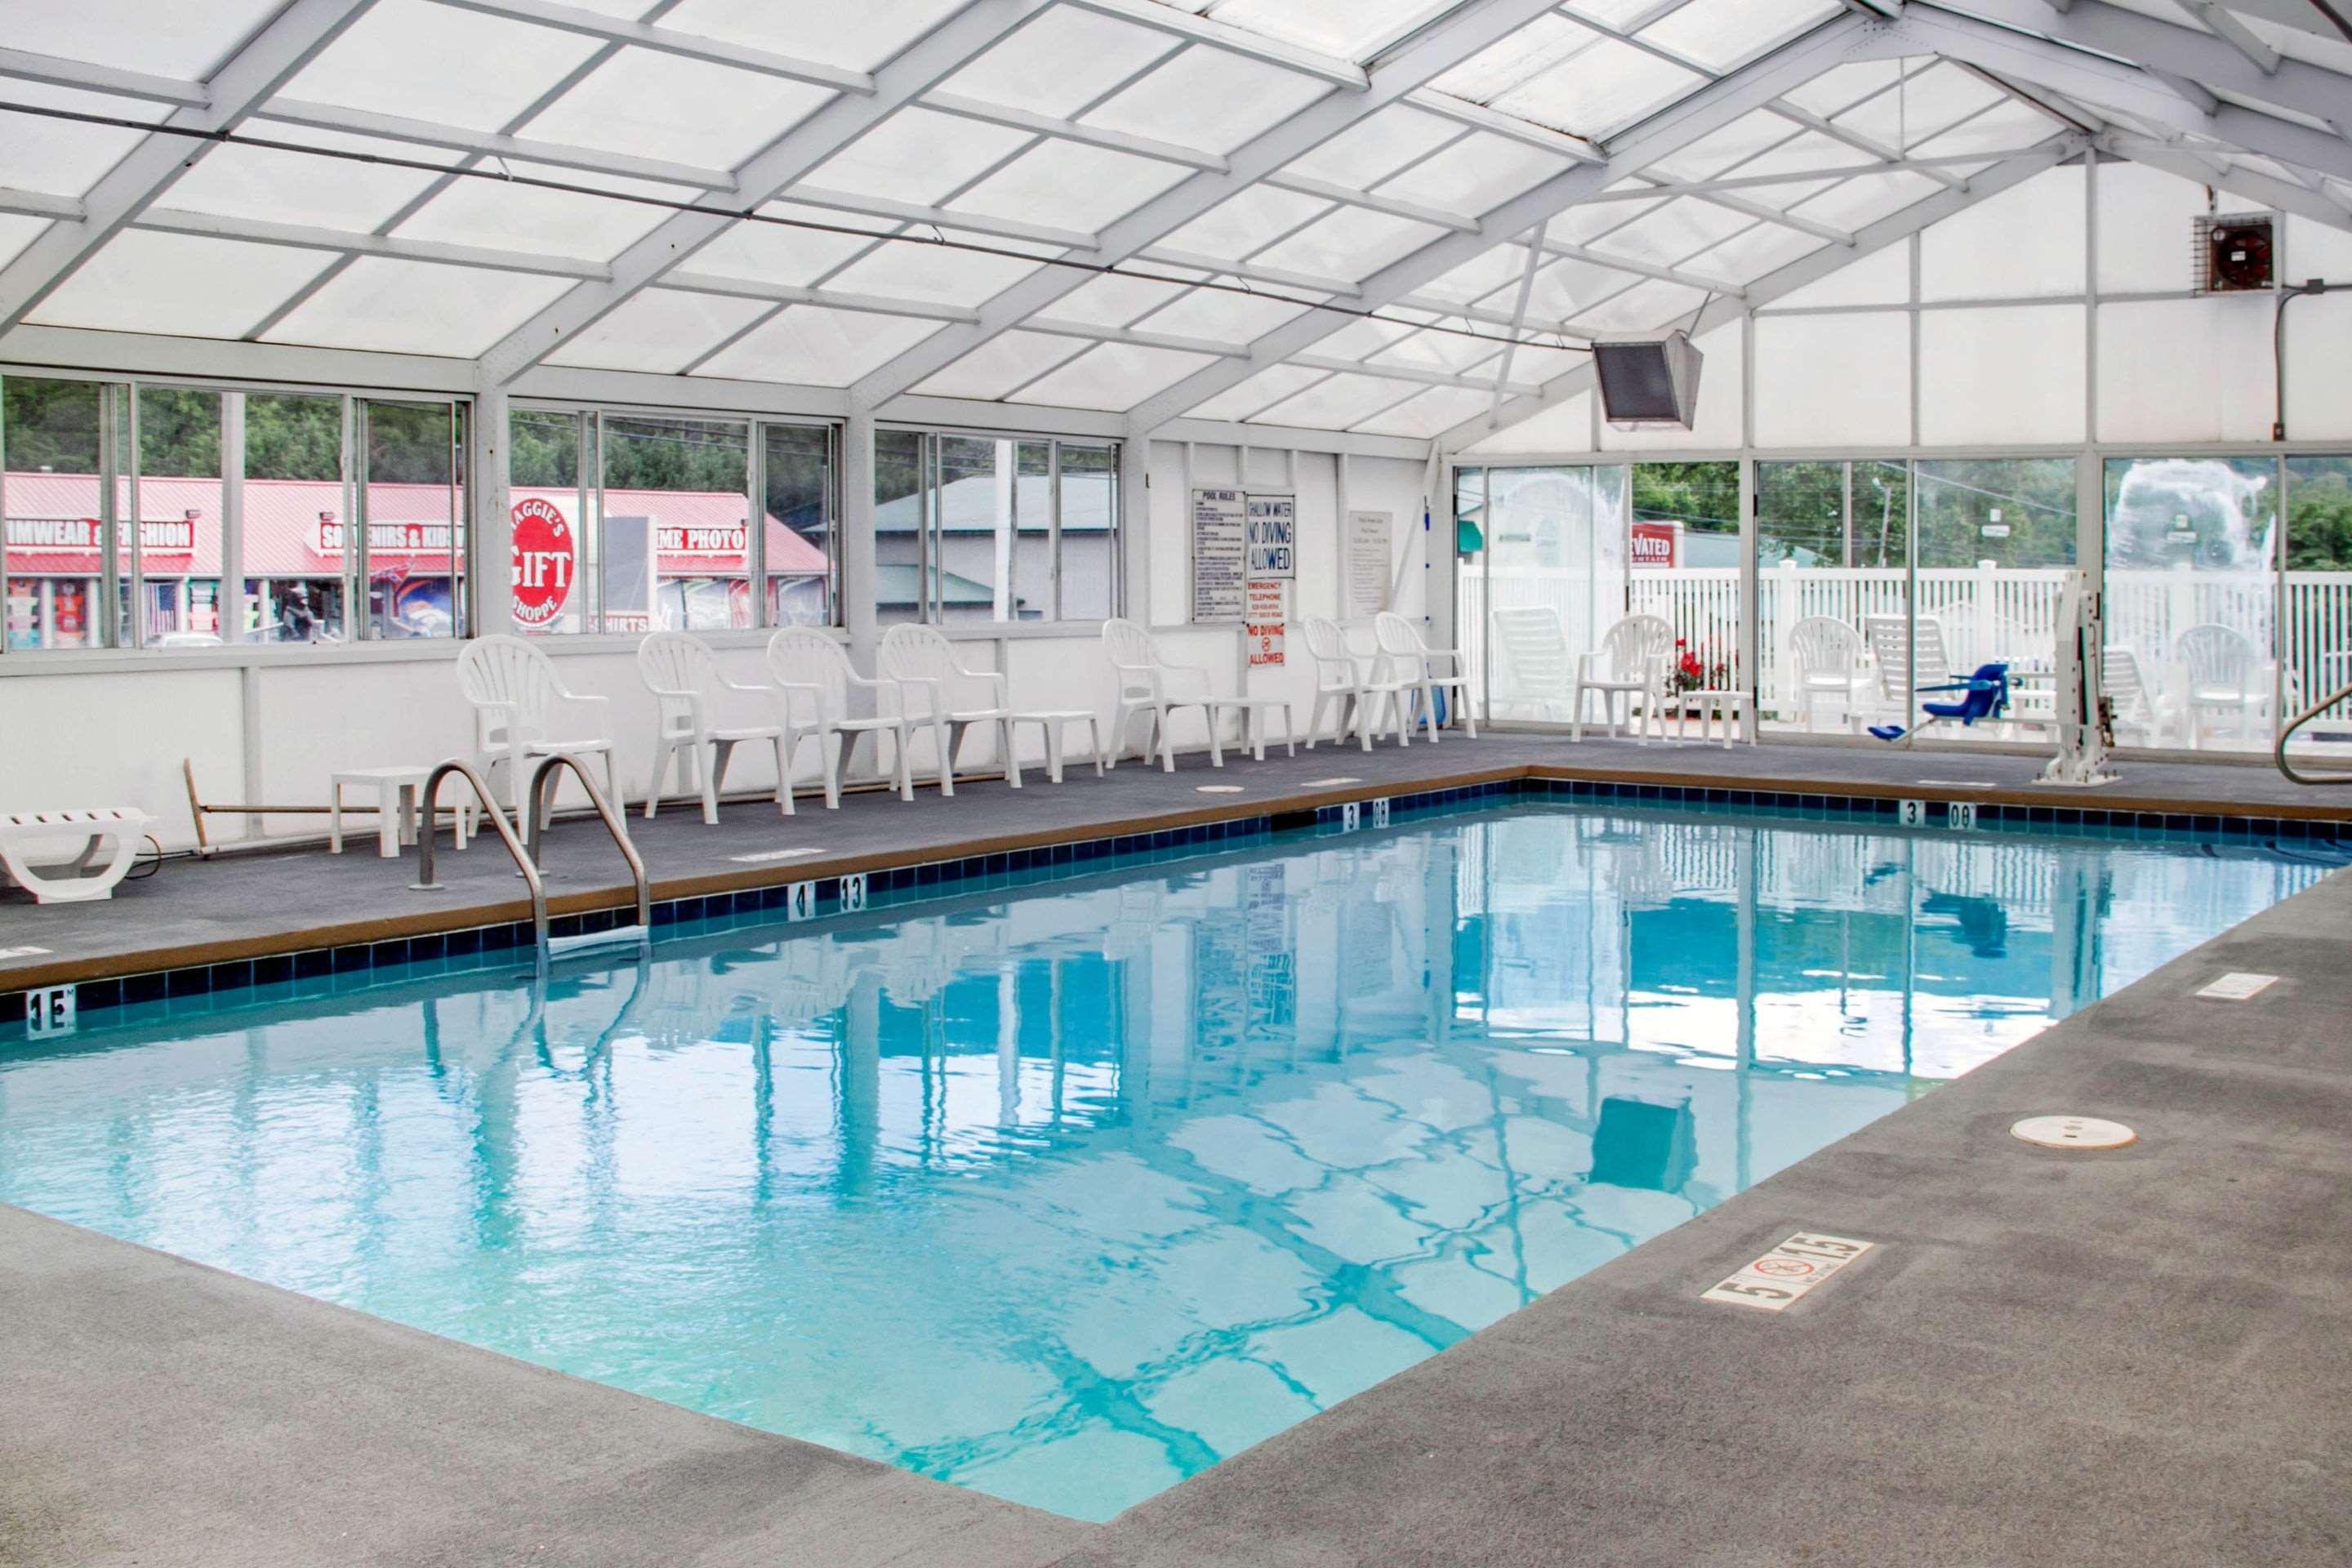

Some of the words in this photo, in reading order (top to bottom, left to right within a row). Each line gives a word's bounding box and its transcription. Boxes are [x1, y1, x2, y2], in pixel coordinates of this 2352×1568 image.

[1203, 492, 1217, 501] POOL
[511, 501, 564, 537] AGGIE'S
[1249, 502, 1271, 516] SHALLOW
[1272, 502, 1292, 517] WATER
[409, 528, 421, 547] &
[688, 530, 744, 550] PHOTO
[1250, 522, 1258, 544] NO
[1262, 522, 1291, 544] DIVING
[1632, 533, 1670, 556] VATED
[1250, 547, 1290, 570] ALLOWED
[1248, 582, 1281, 590] EMERGENCY
[1248, 626, 1258, 636] NO
[1260, 626, 1285, 636] DIVING
[1250, 653, 1285, 665] ALLOWED
[1717, 1281, 1793, 1300] 5
